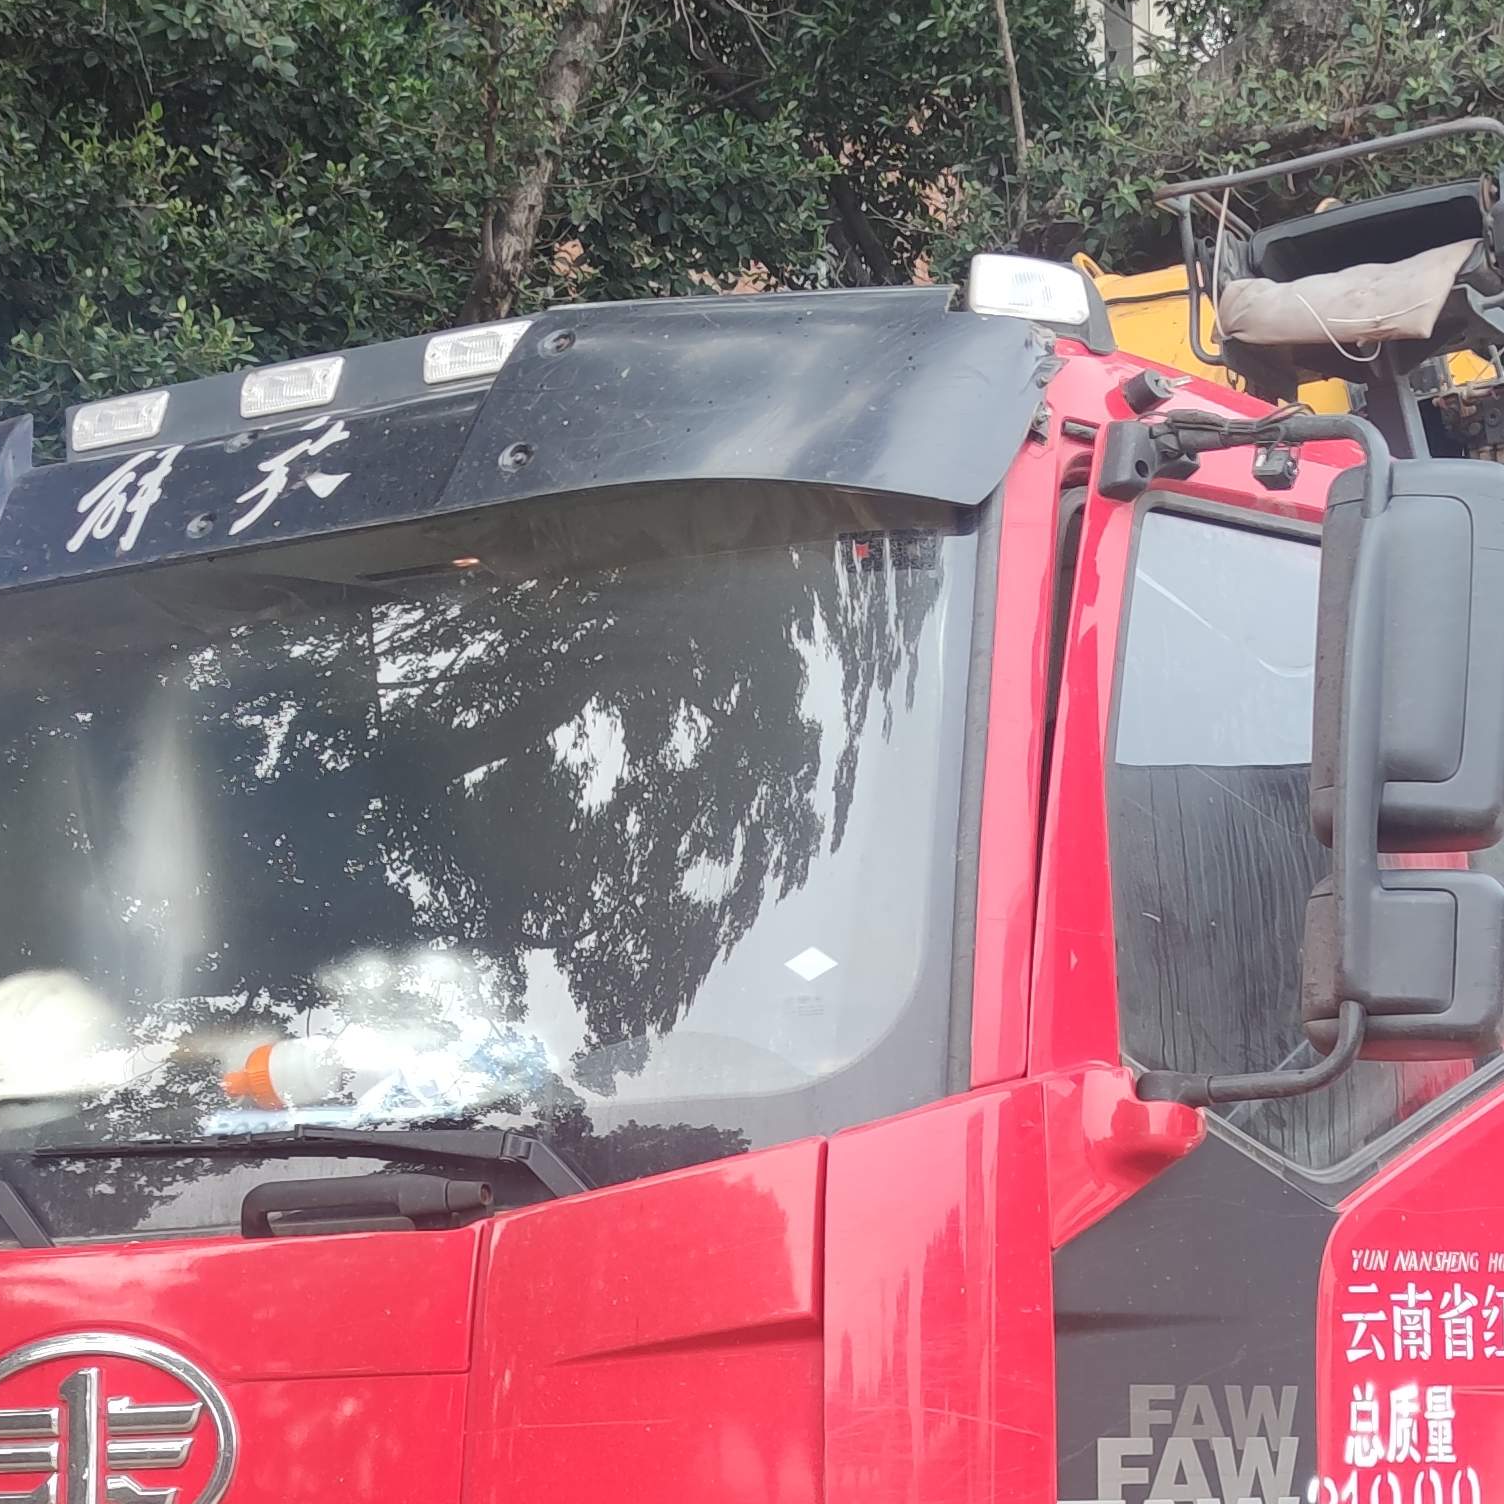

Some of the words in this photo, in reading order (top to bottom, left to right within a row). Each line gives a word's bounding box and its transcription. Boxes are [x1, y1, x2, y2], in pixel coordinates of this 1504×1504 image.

[1351, 1249, 1389, 1272] YUN
[1343, 1382, 1458, 1467] 总质量
